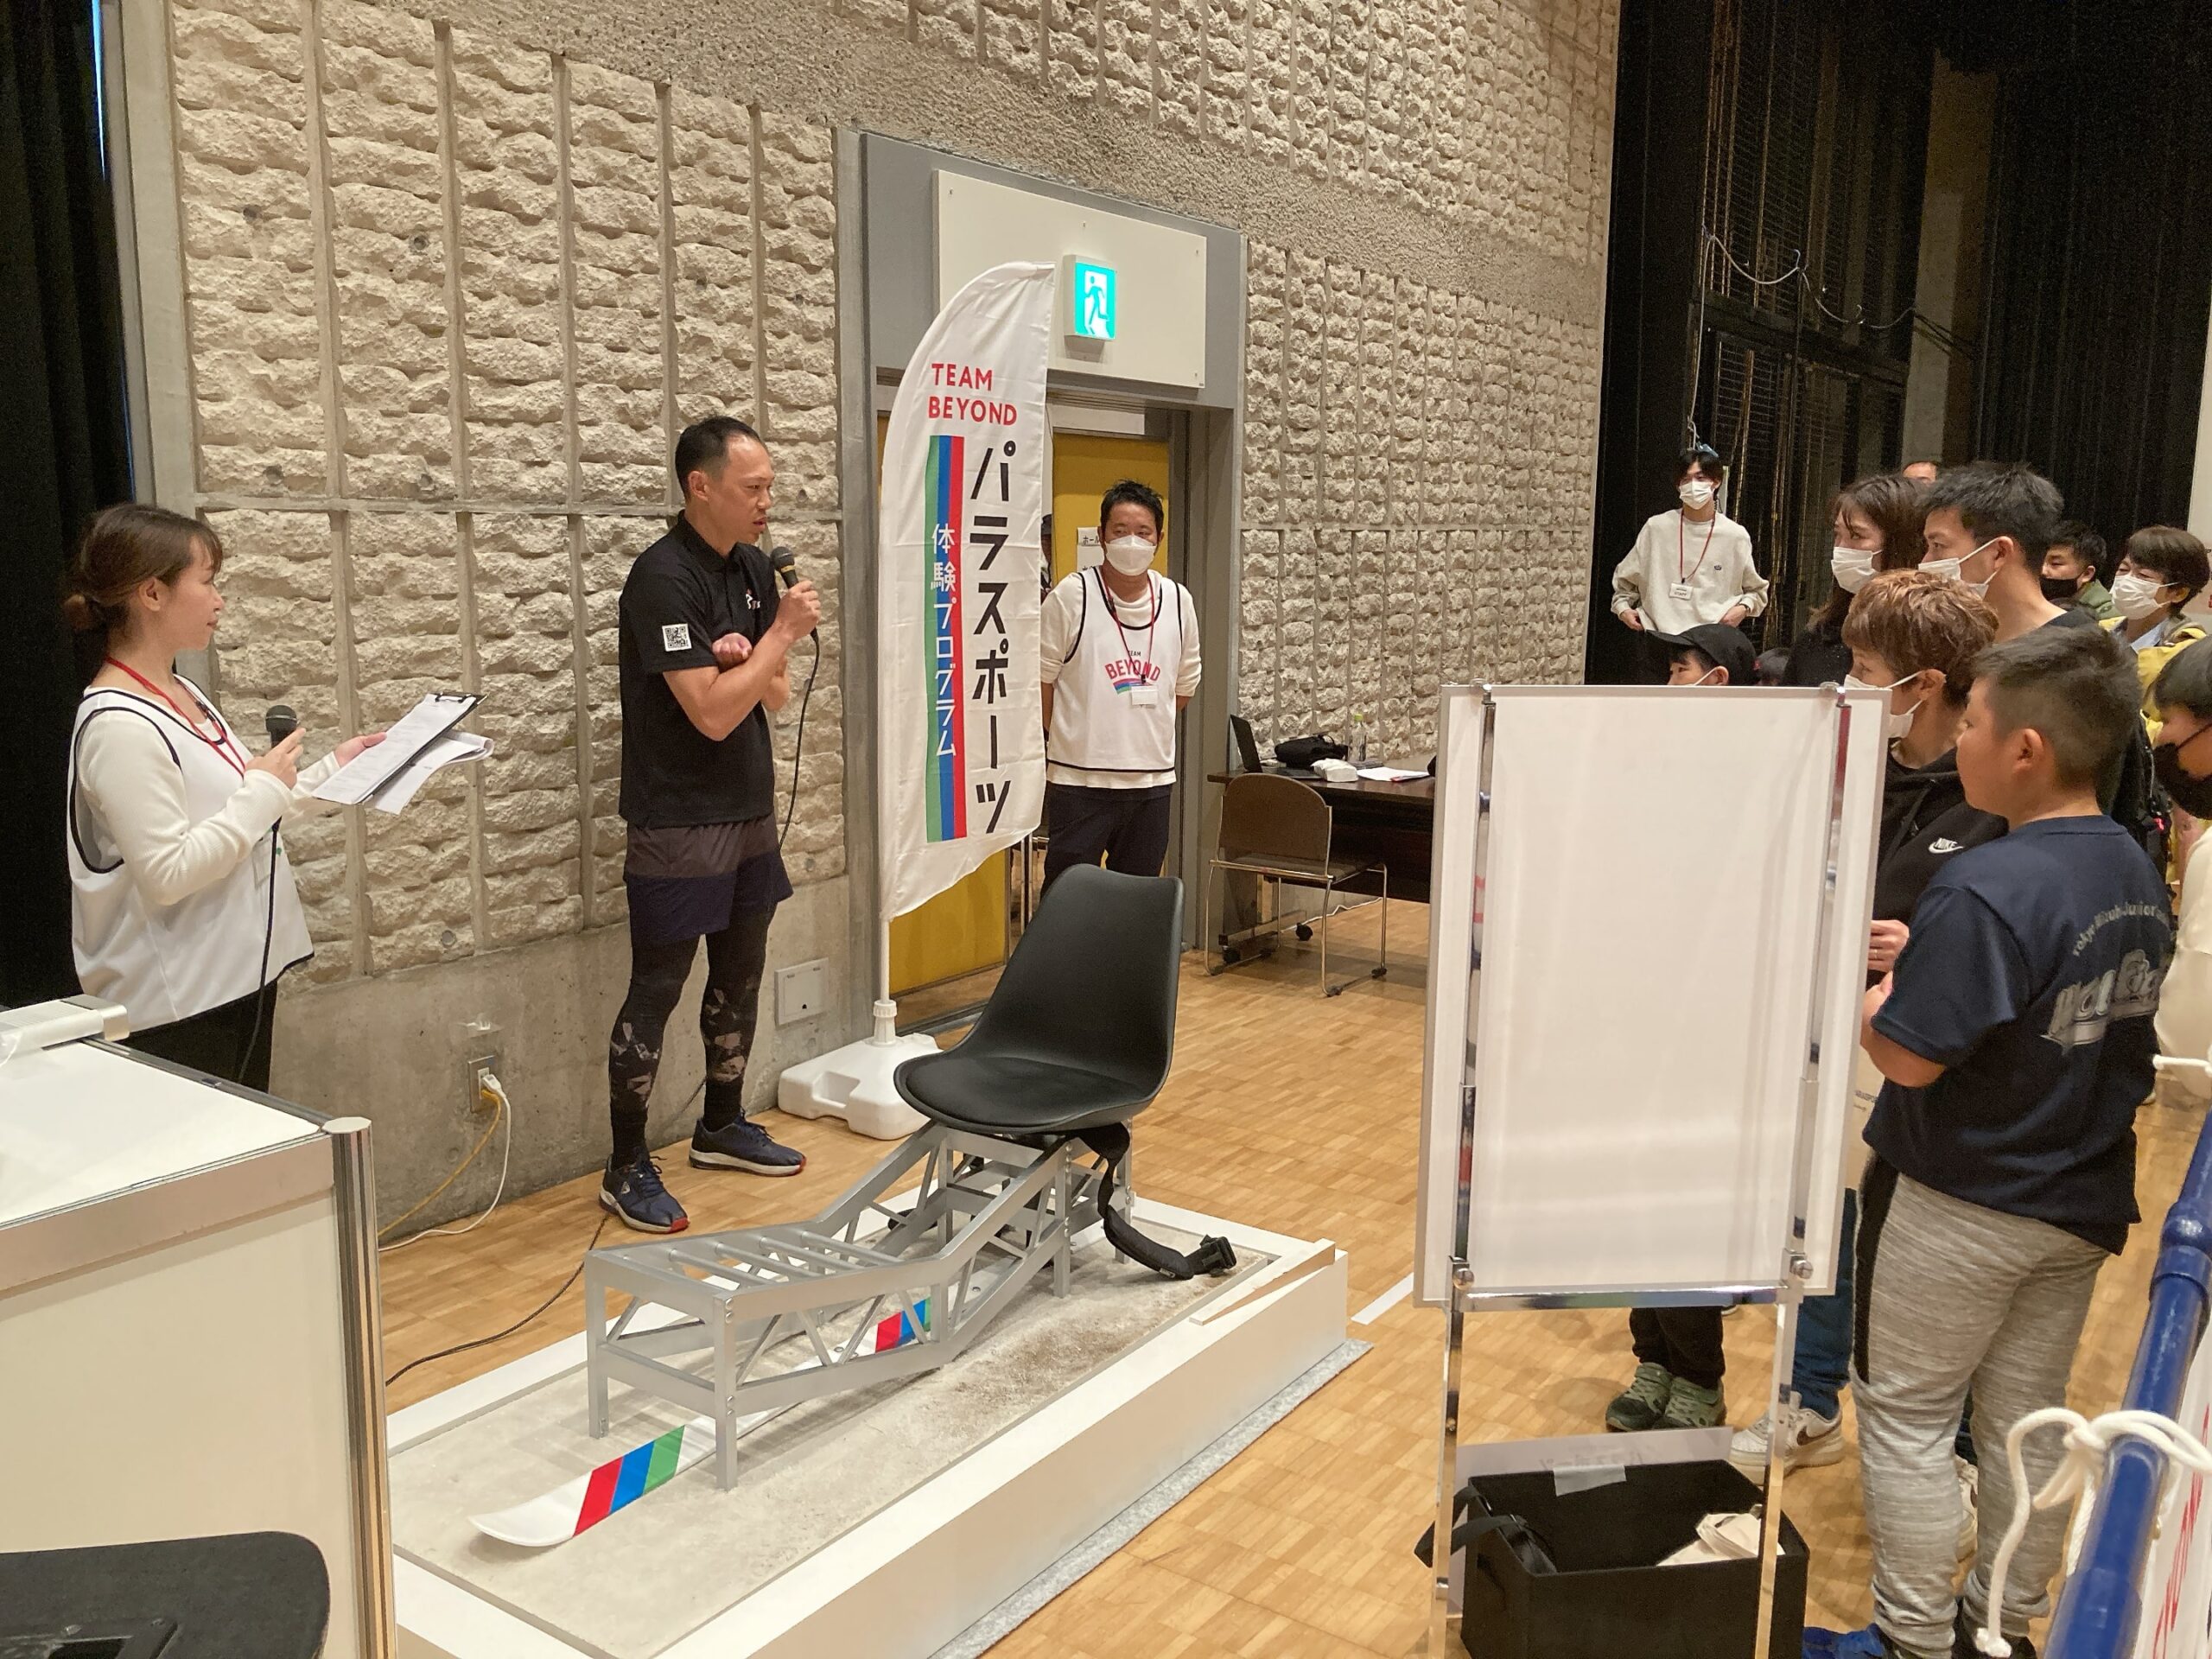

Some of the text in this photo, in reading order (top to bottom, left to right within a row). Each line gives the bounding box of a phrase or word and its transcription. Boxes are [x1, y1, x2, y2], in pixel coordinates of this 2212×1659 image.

[931, 363, 993, 391] TEAM
[928, 396, 1018, 426] BEYOND
[931, 523, 957, 757] 体験プログラム
[969, 439, 1017, 835] パラスポーツ
[1104, 658, 1161, 681] BEYOND
